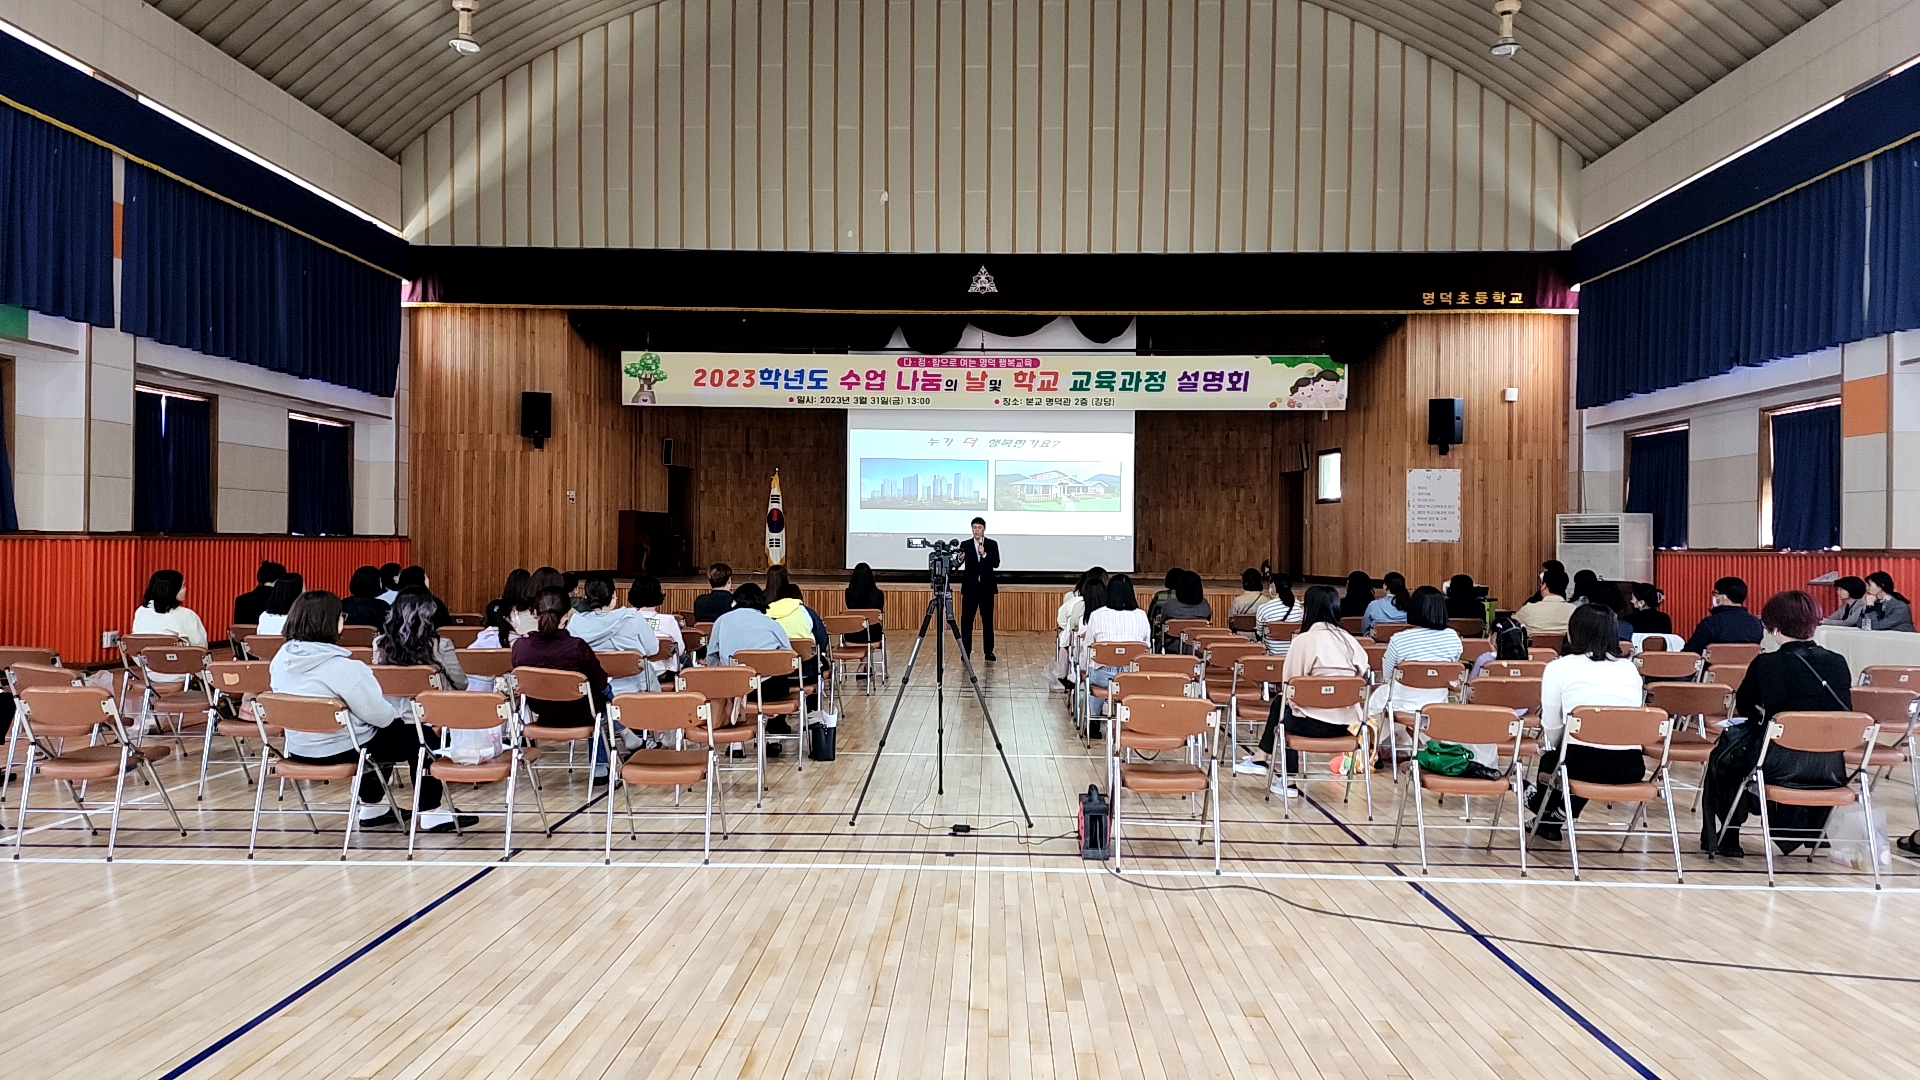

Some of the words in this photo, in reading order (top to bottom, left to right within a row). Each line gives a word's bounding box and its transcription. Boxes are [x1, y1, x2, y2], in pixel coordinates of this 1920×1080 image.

[1422, 291, 1525, 306] 명덕초등학교
[960, 357, 977, 368] 여는
[979, 358, 996, 368] 명덕
[998, 358, 1033, 368] 행복교육
[693, 367, 829, 390] 2023학년도
[839, 369, 887, 391] 수업
[896, 369, 958, 392] 나눔의
[1013, 370, 1060, 393] 학교
[1068, 370, 1167, 393] 교육과정
[1177, 370, 1250, 393] 설명회
[796, 395, 817, 405] 일시:
[819, 395, 850, 405] 2023년
[853, 396, 868, 406] 3월
[870, 396, 904, 406] 31일(금)
[906, 396, 931, 405] 13:00
[1002, 397, 1023, 407] 장소:
[1025, 397, 1043, 407] 본교
[1045, 397, 1072, 407] 명덕관
[1074, 397, 1089, 407] 2층
[927, 437, 954, 447] 누가
[962, 437, 979, 448] 더
[988, 438, 1061, 449] 행복한가요?
